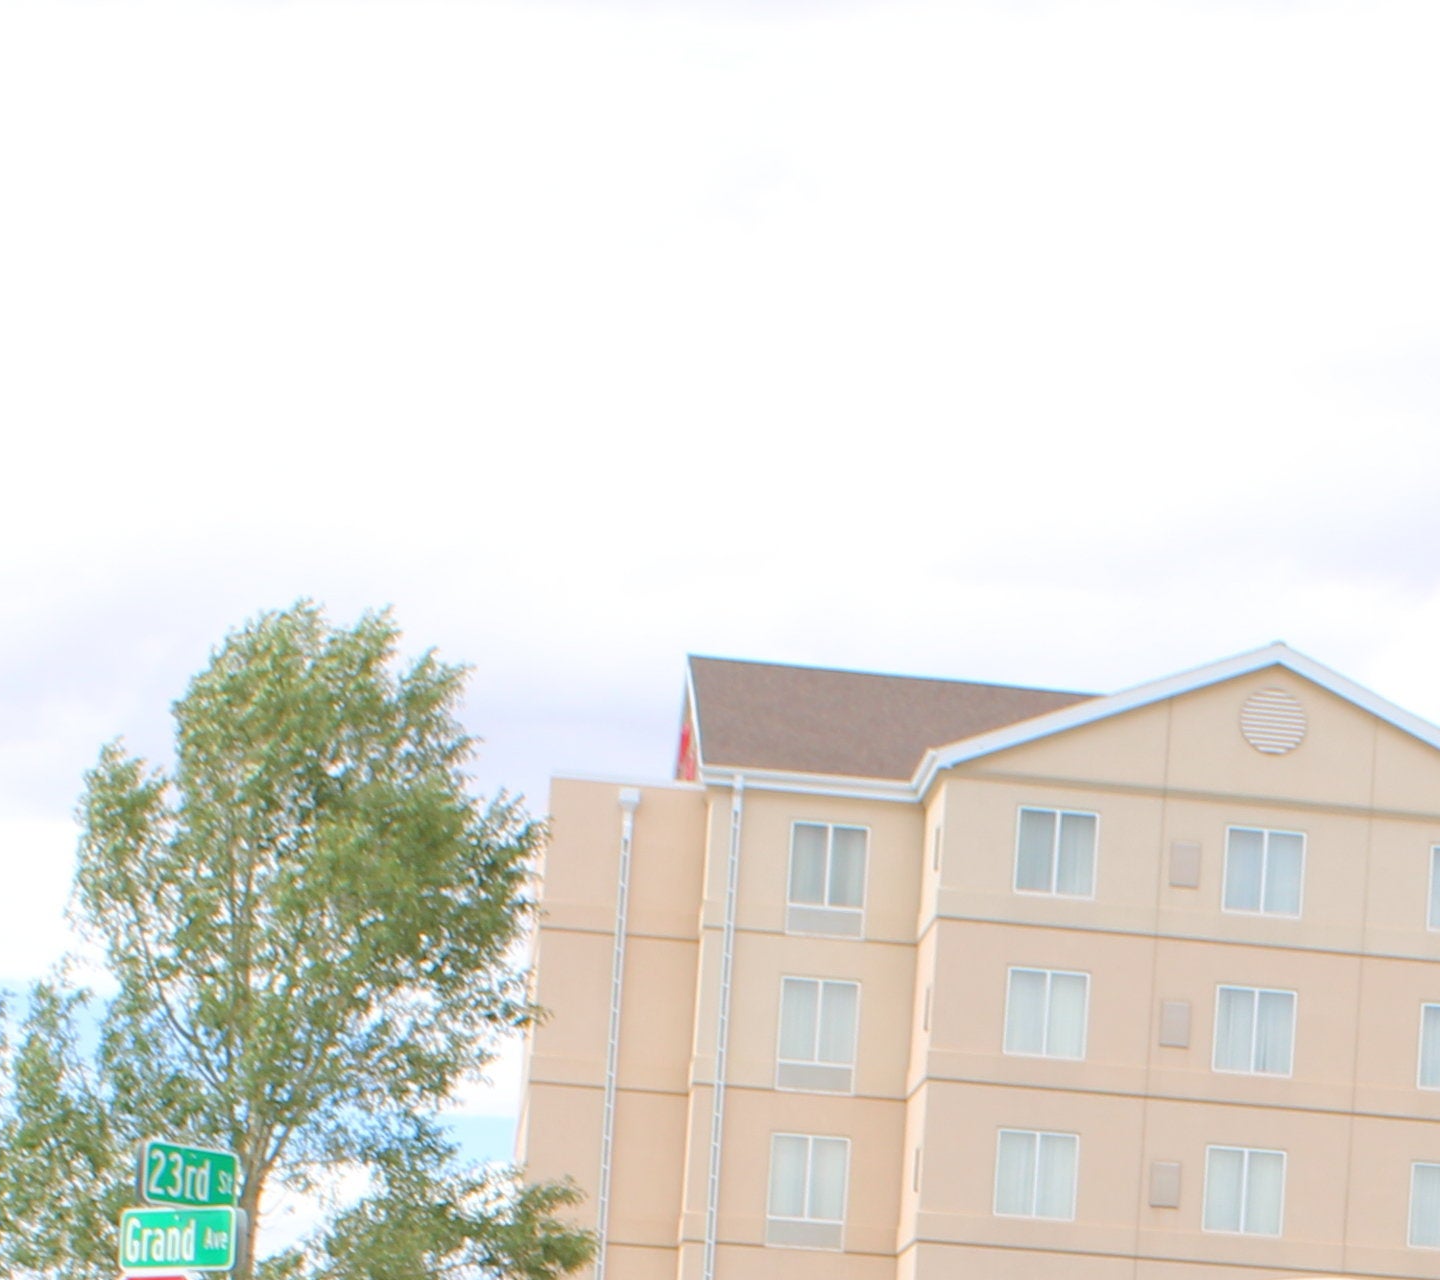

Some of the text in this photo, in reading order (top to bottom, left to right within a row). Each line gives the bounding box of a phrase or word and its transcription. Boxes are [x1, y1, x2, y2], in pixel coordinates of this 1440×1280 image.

[150, 1151, 210, 1201] 23rd
[125, 1217, 228, 1263] Grand Ave
